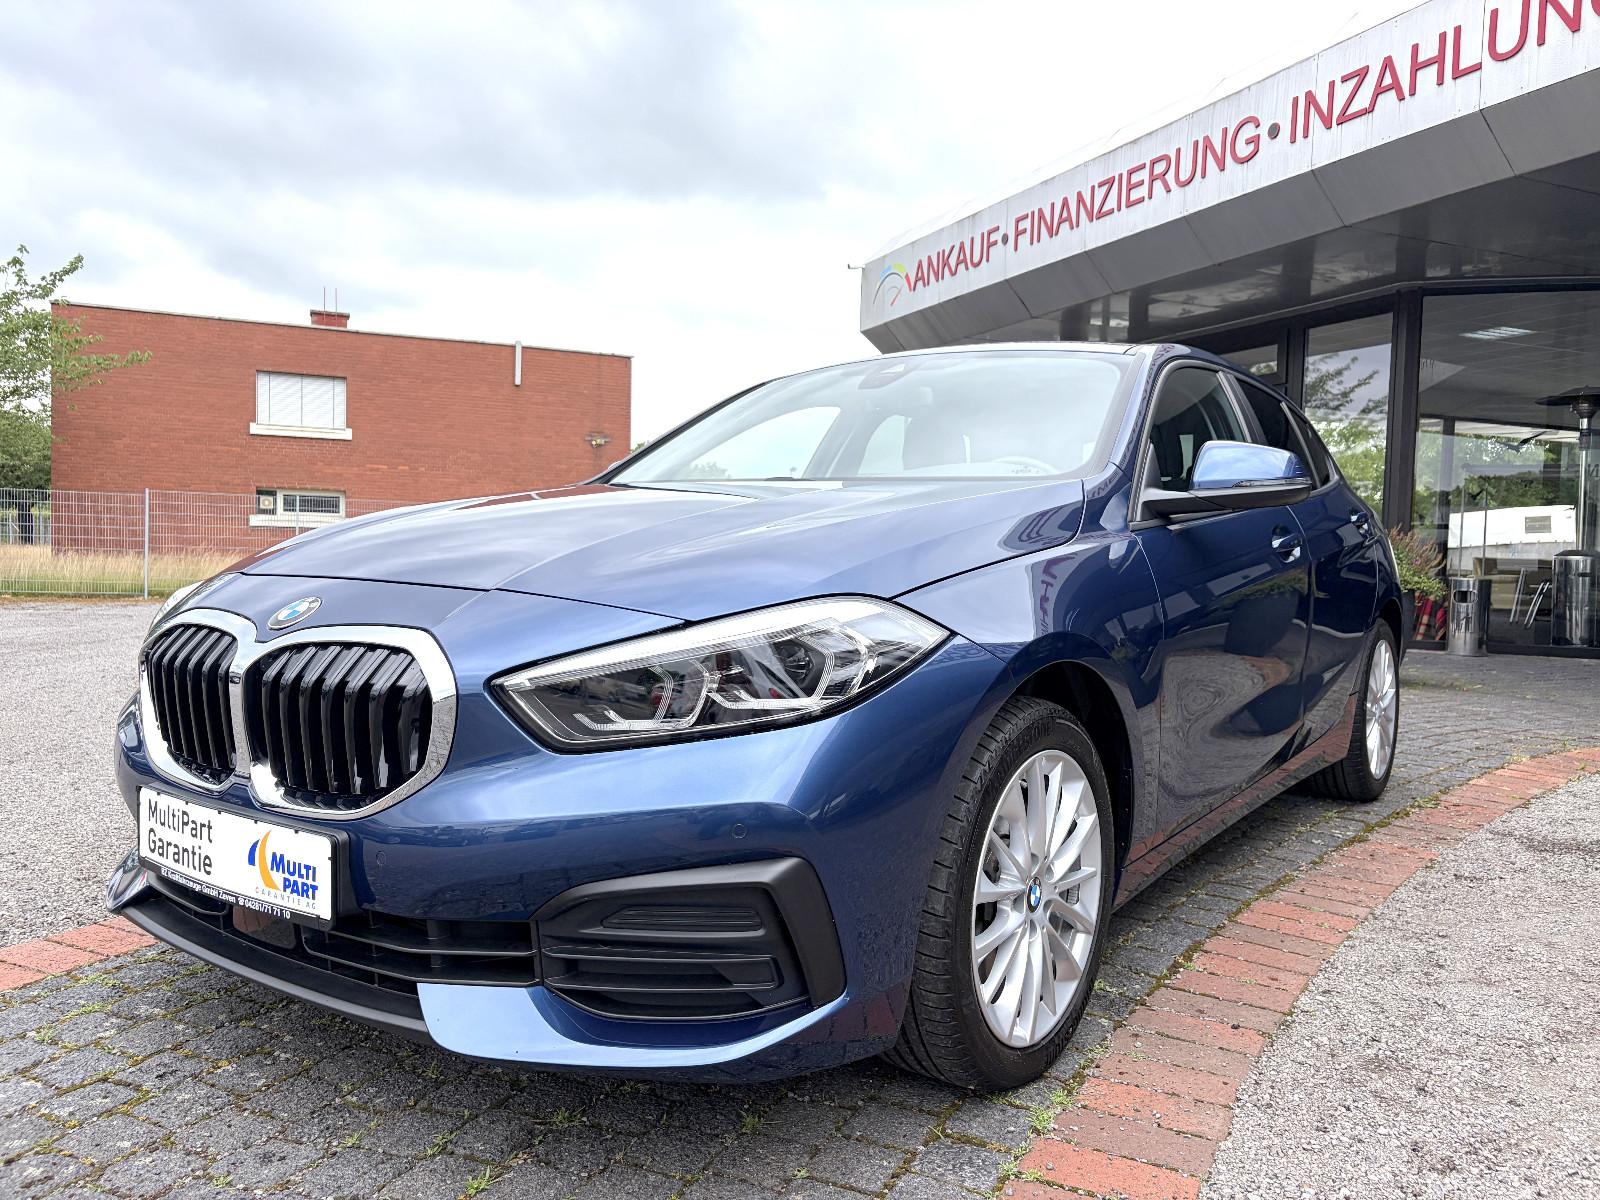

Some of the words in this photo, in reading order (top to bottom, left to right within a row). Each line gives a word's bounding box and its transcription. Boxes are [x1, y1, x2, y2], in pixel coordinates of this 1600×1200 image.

[912, 225, 1000, 292] ANKAUF
[1013, 115, 1261, 252] FINANZIERUNG
[1289, 0, 1600, 144] INZAHLUN
[148, 798, 213, 844] MultiPart
[148, 828, 213, 876] Garantie
[202, 884, 219, 898] GmbH
[219, 891, 236, 903] Zeven
[273, 906, 281, 917] 71
[282, 910, 291, 919] 10
[255, 887, 301, 905] GARANTIE
[306, 902, 316, 910] AG
[283, 877, 318, 900] PART
